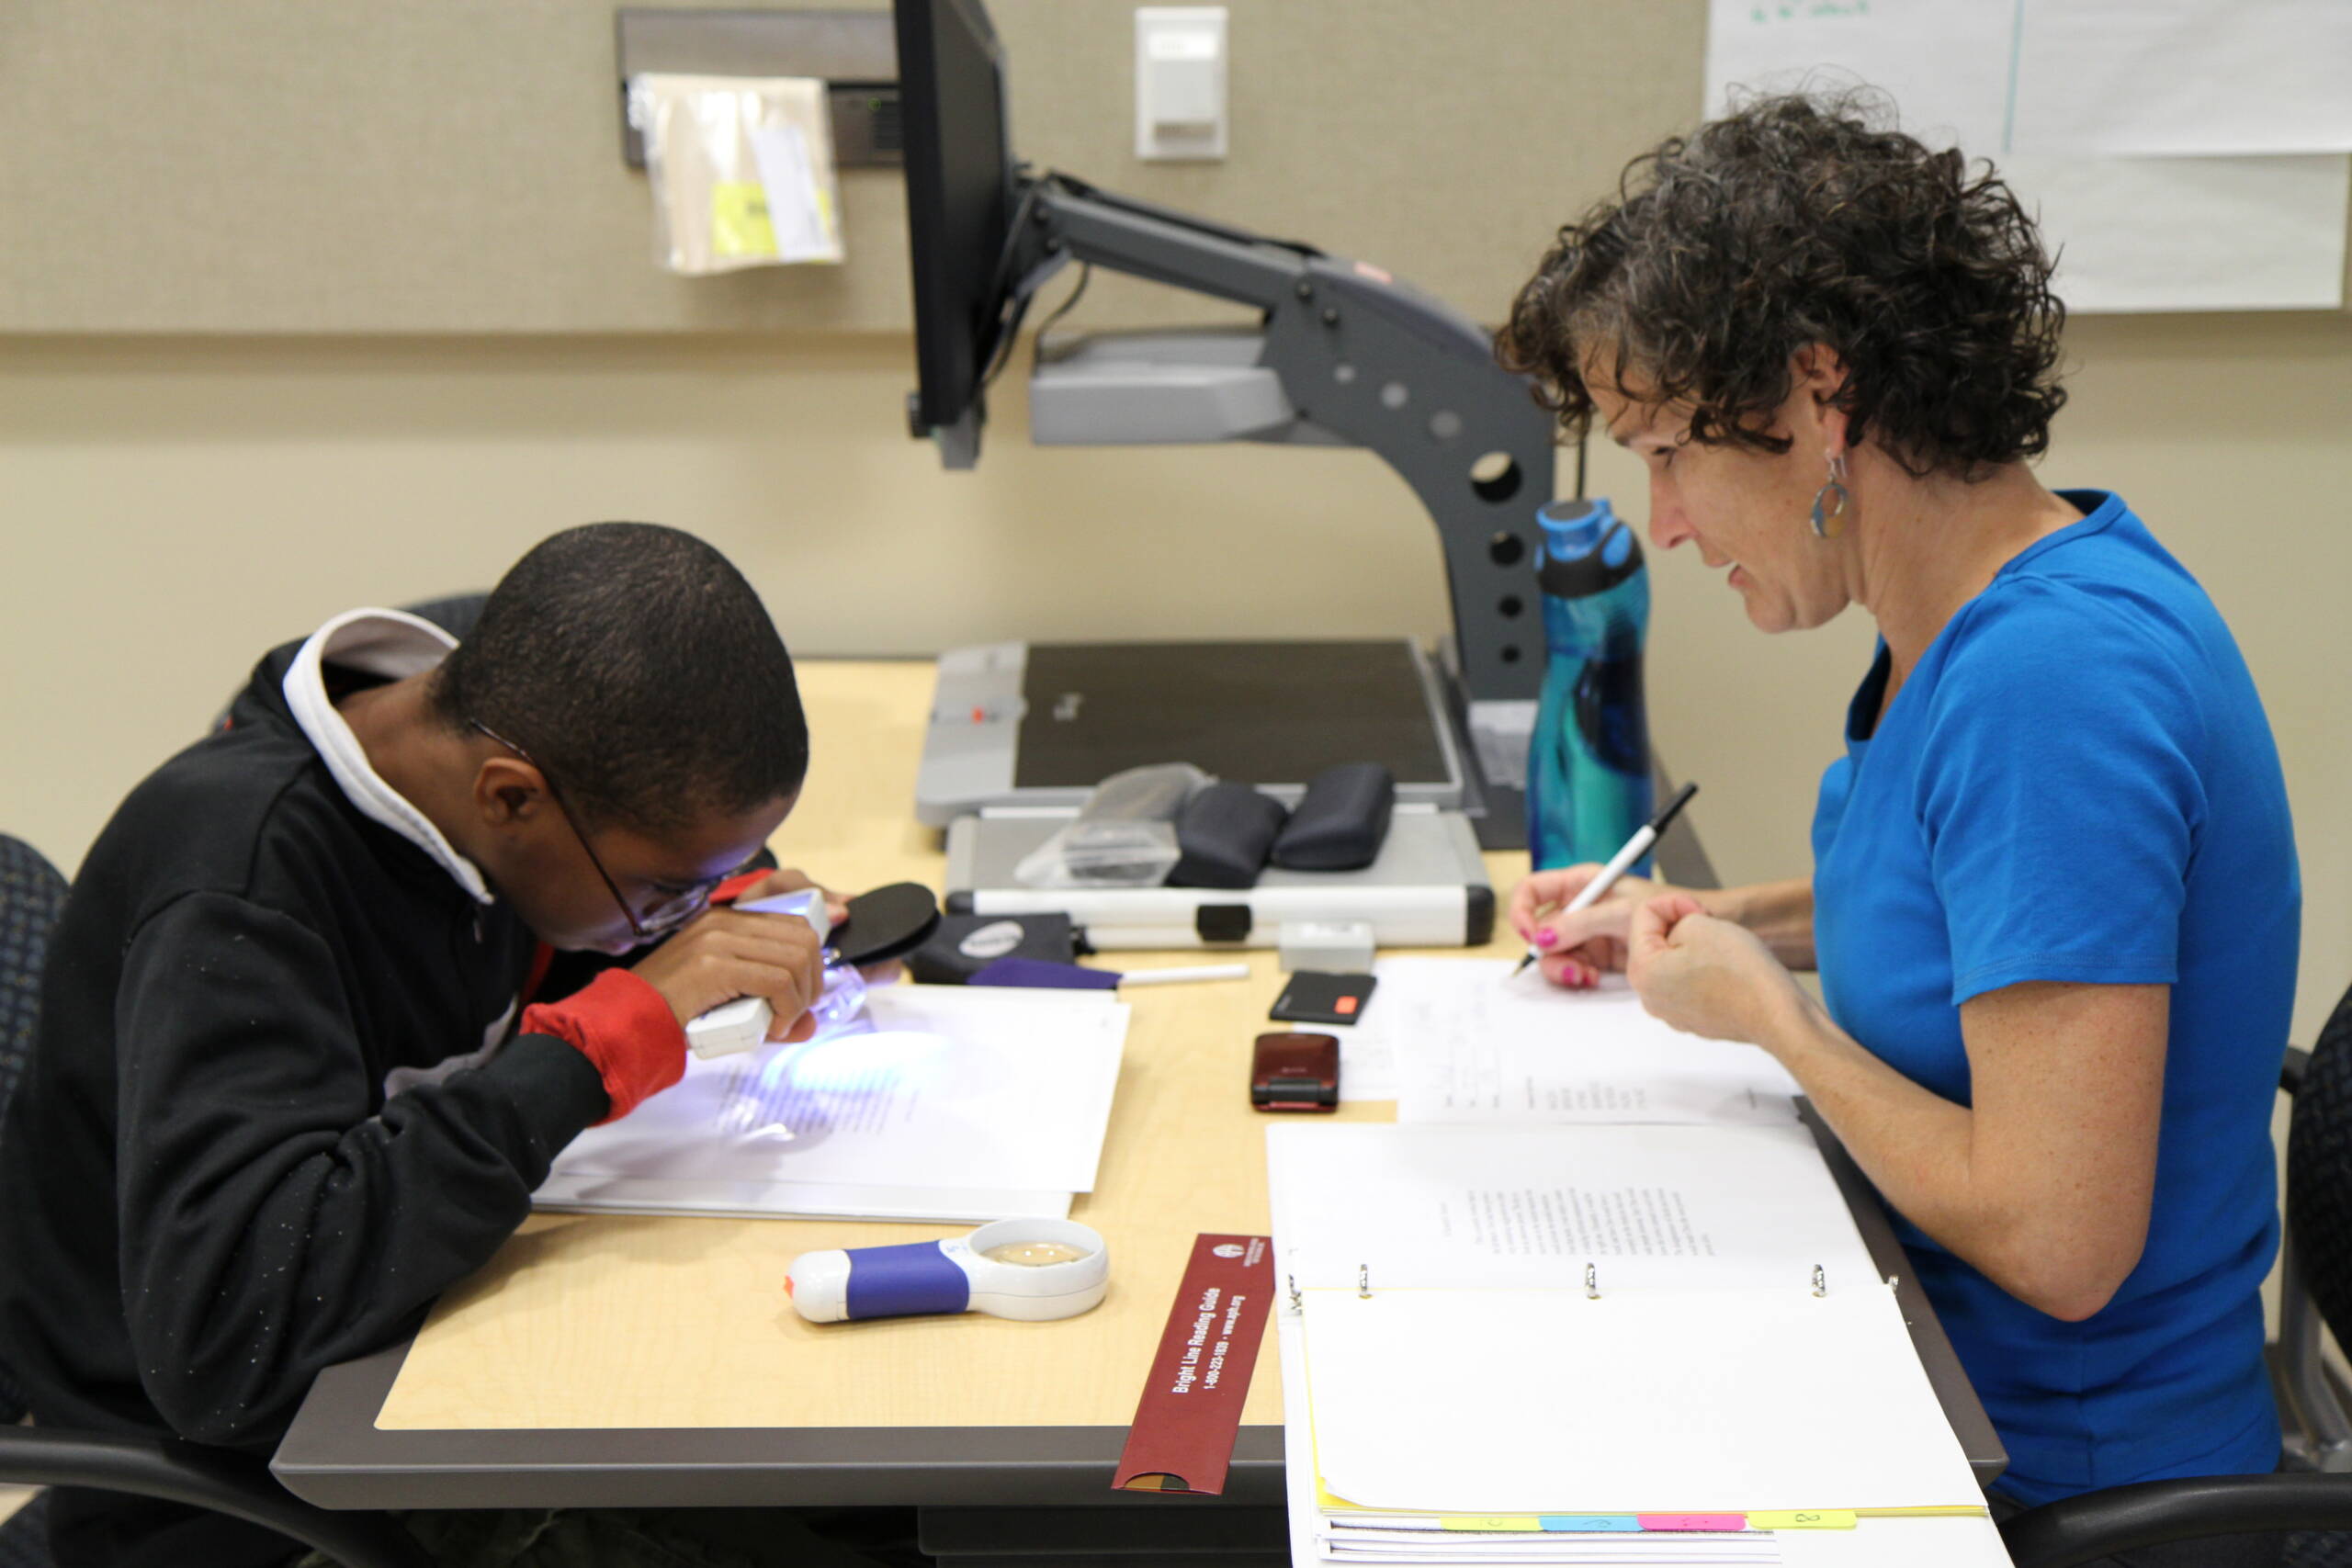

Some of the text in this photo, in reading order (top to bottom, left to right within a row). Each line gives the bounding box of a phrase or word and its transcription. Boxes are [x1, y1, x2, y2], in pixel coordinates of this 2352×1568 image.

[1171, 1287, 1221, 1393] Bright Line Reading Guide
[1203, 1294, 1247, 1389] 1-800-223-1839 www.aph.org
